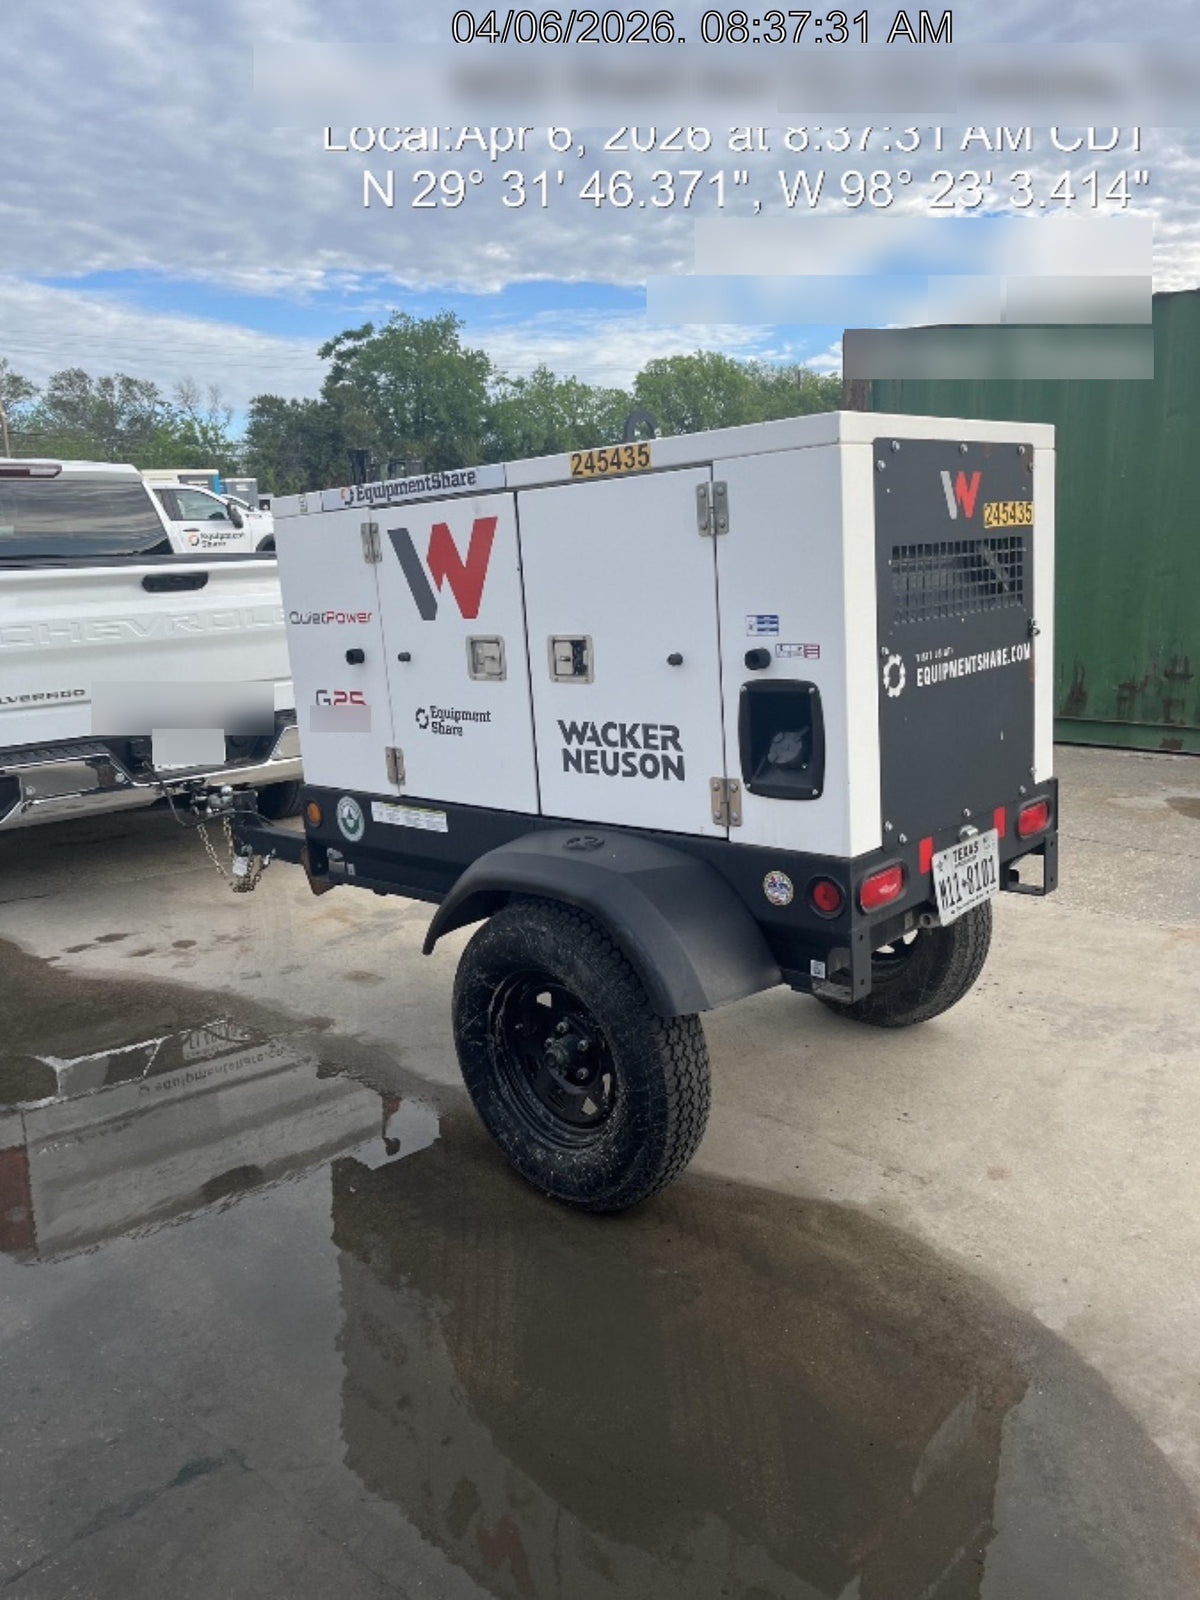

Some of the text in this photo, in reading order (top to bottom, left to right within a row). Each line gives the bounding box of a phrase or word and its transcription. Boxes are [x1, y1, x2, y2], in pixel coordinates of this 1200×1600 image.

[571, 443, 651, 476] 245435
[356, 469, 476, 503] EquipmentShare
[985, 502, 1033, 525] 245435
[289, 611, 373, 625] QuietPower
[916, 642, 1031, 687] EQUIPMENTSHARE.COM
[430, 705, 492, 723] Equipment
[431, 721, 464, 737] Share
[557, 719, 684, 752] WACKER
[562, 748, 686, 781] NEUSON
[953, 841, 979, 863] TEXAS
